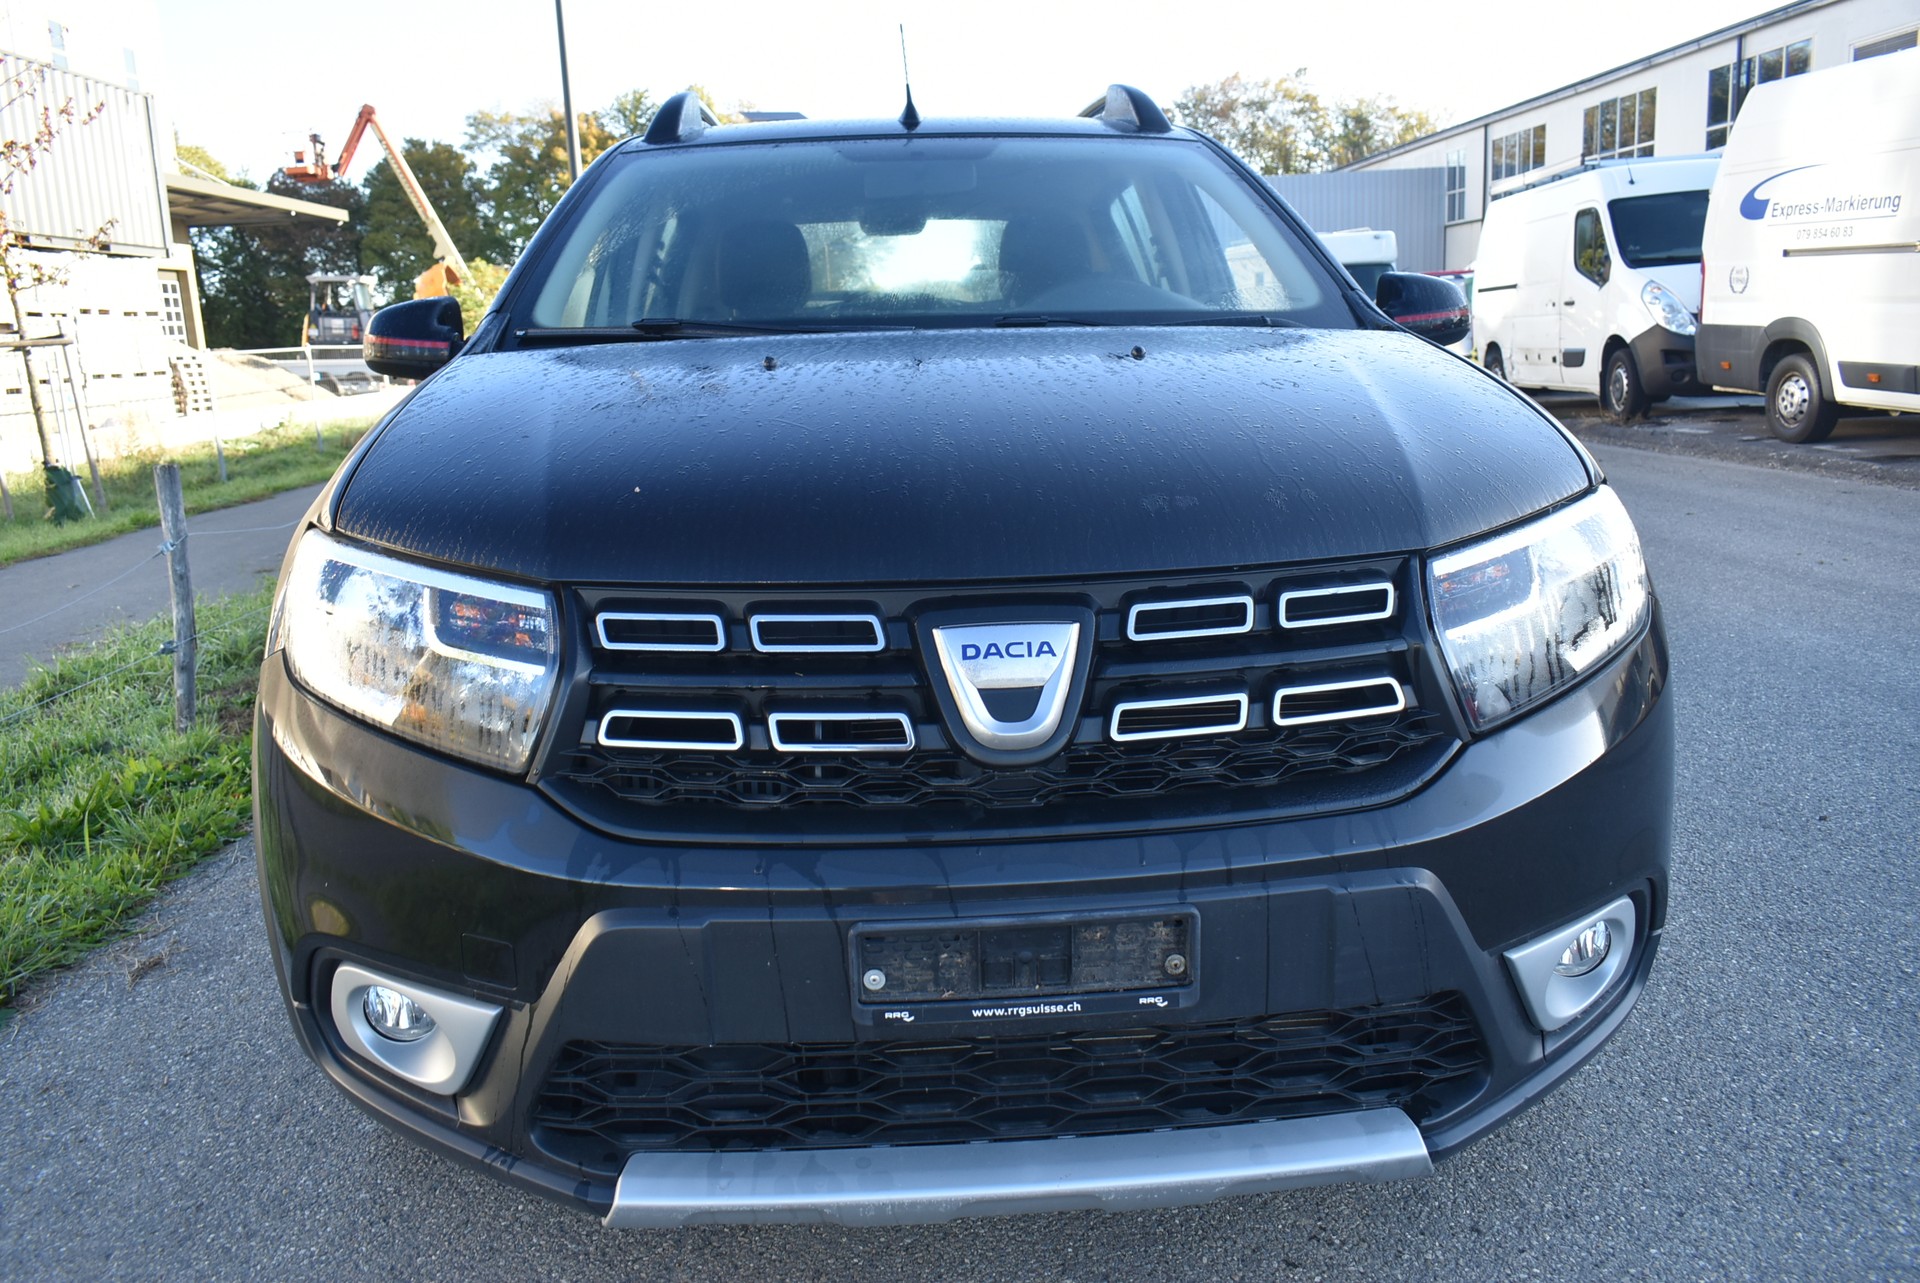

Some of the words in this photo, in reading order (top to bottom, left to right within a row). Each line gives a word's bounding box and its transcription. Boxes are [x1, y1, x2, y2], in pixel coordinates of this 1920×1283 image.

[1771, 195, 1902, 219] Express-Markierung
[1796, 229, 1811, 240] 079
[1830, 227, 1841, 238] 60
[1843, 226, 1854, 237] 83
[961, 640, 1057, 661] DACIA
[972, 1002, 1081, 1018] www.rrgsuisse.ch
